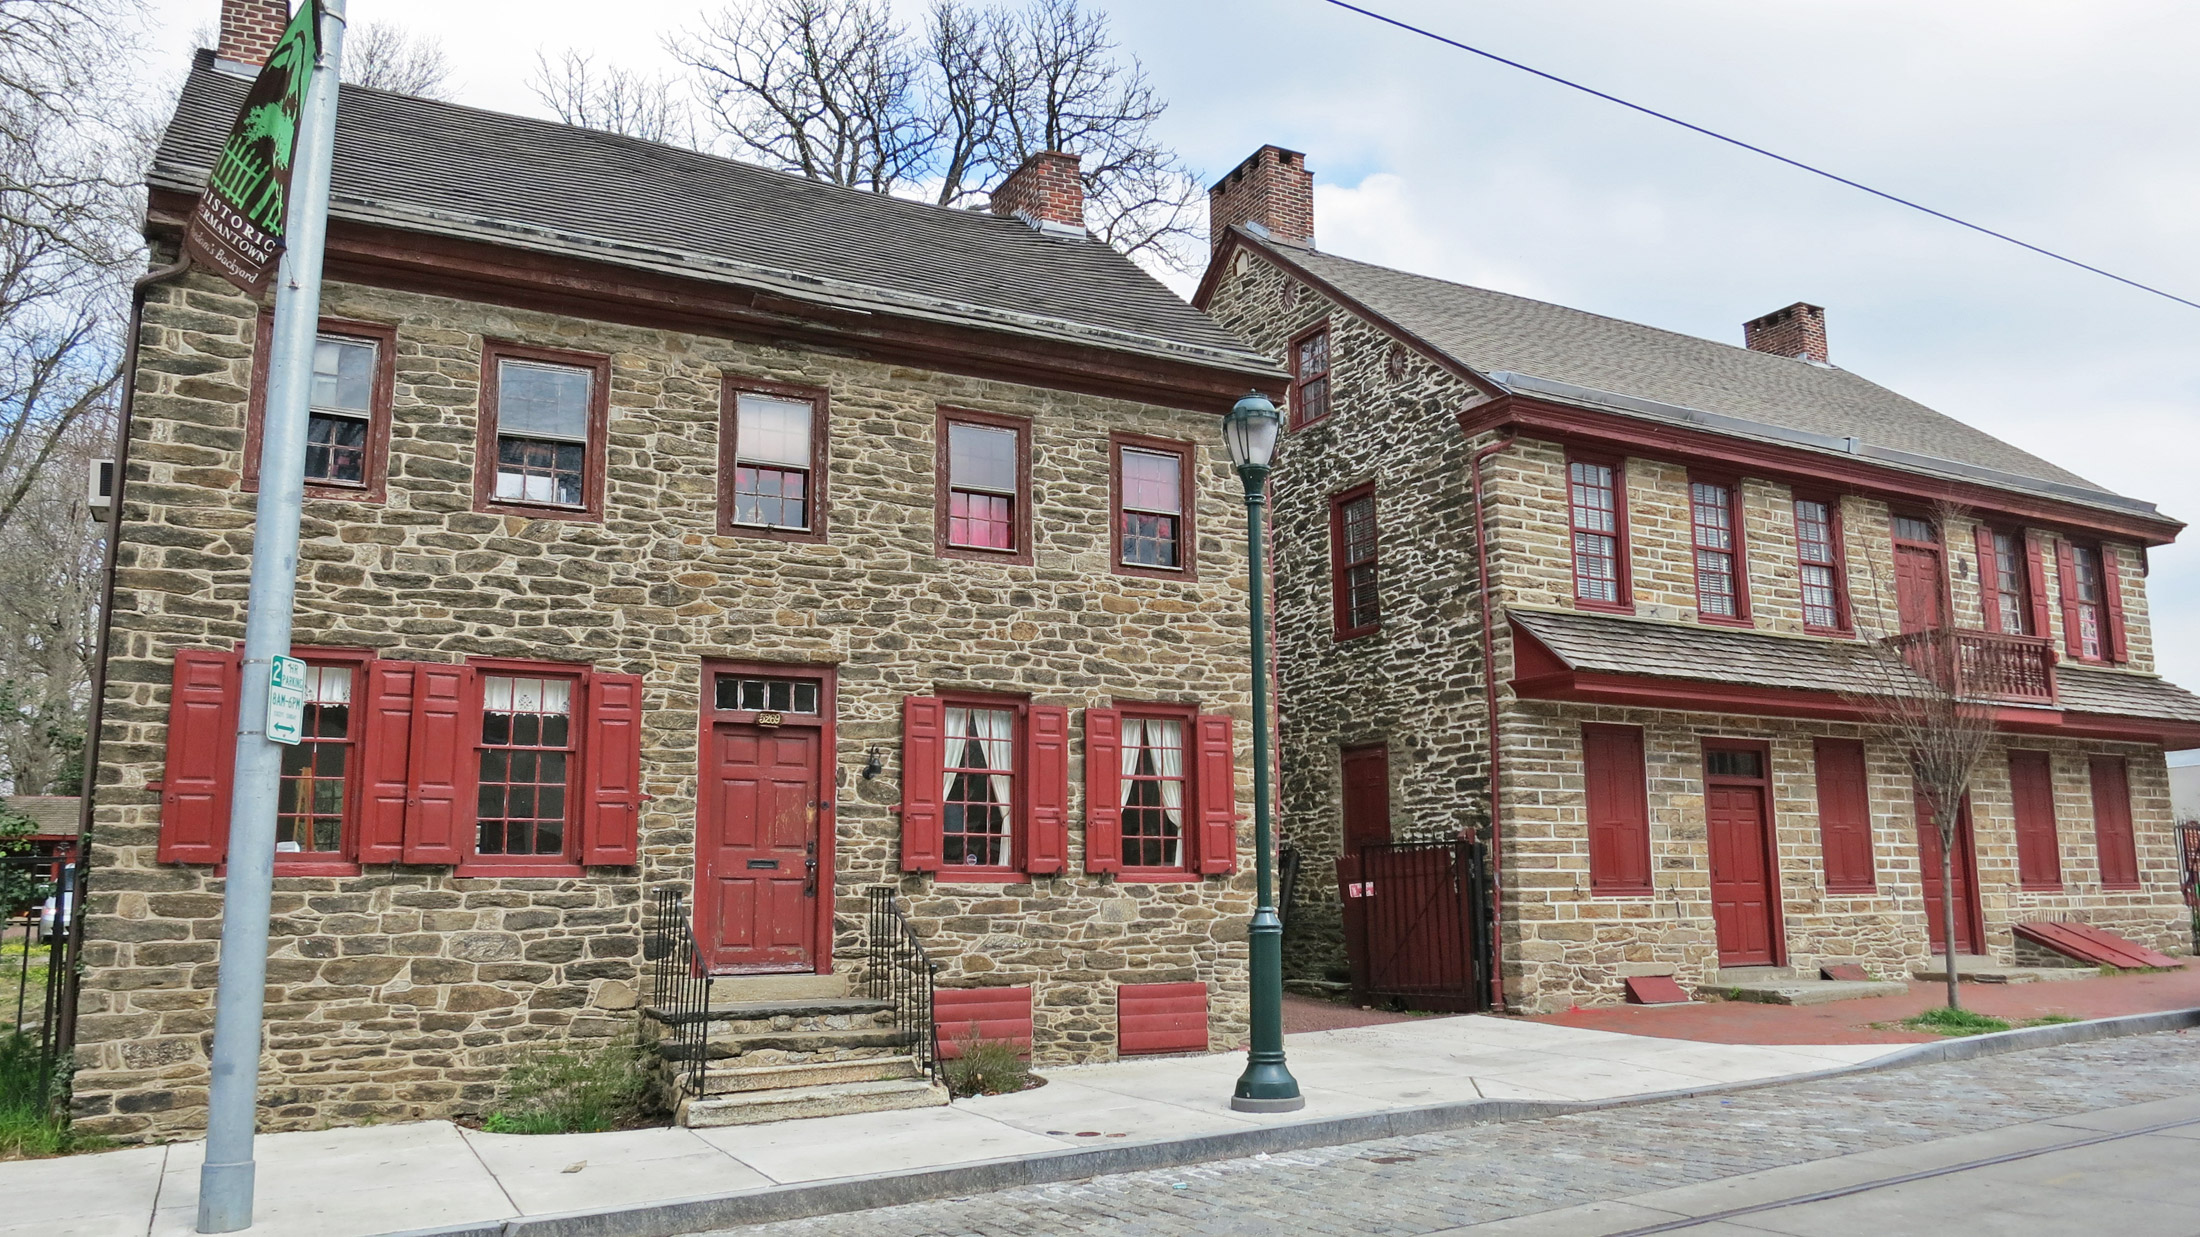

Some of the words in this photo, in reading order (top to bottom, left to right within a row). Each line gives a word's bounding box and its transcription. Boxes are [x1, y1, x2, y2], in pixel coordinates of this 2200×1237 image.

[198, 204, 269, 264] RMANTOWN
[214, 248, 259, 284] Backyard
[273, 661, 281, 681] 2
[282, 674, 304, 689] PARKING
[758, 713, 781, 724] 5269
